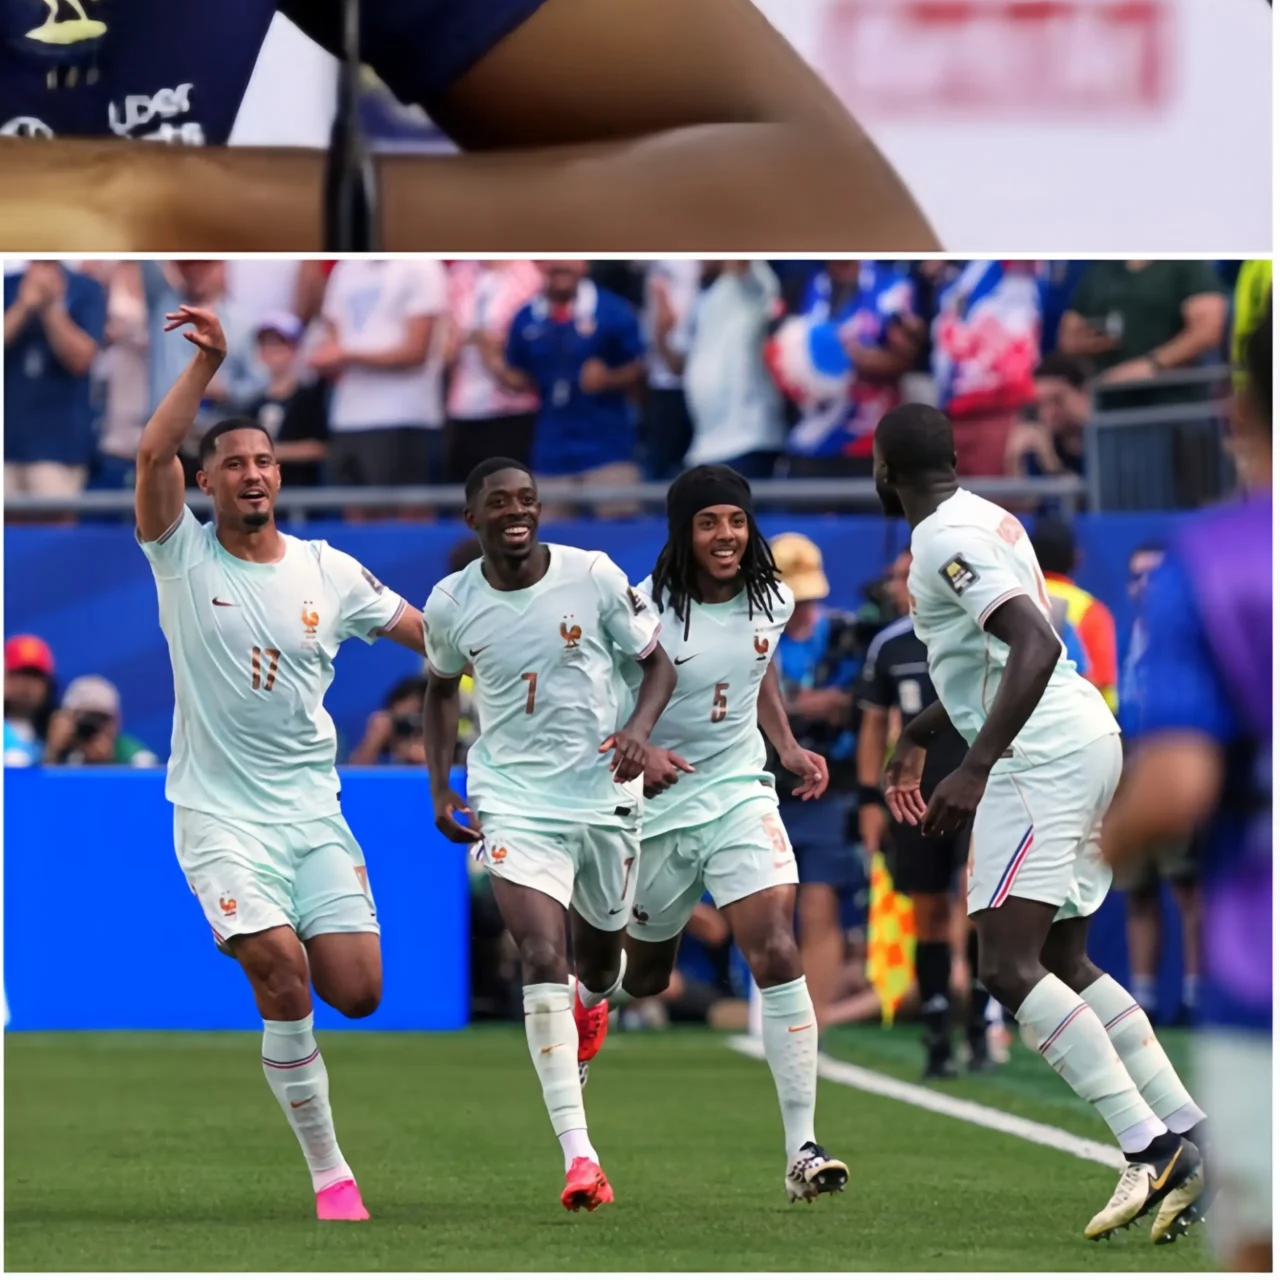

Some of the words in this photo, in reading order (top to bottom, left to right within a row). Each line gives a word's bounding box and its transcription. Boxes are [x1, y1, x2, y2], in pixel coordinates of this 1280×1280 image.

[252, 646, 281, 691] 17
[521, 672, 538, 715] 7
[711, 682, 730, 723] 5
